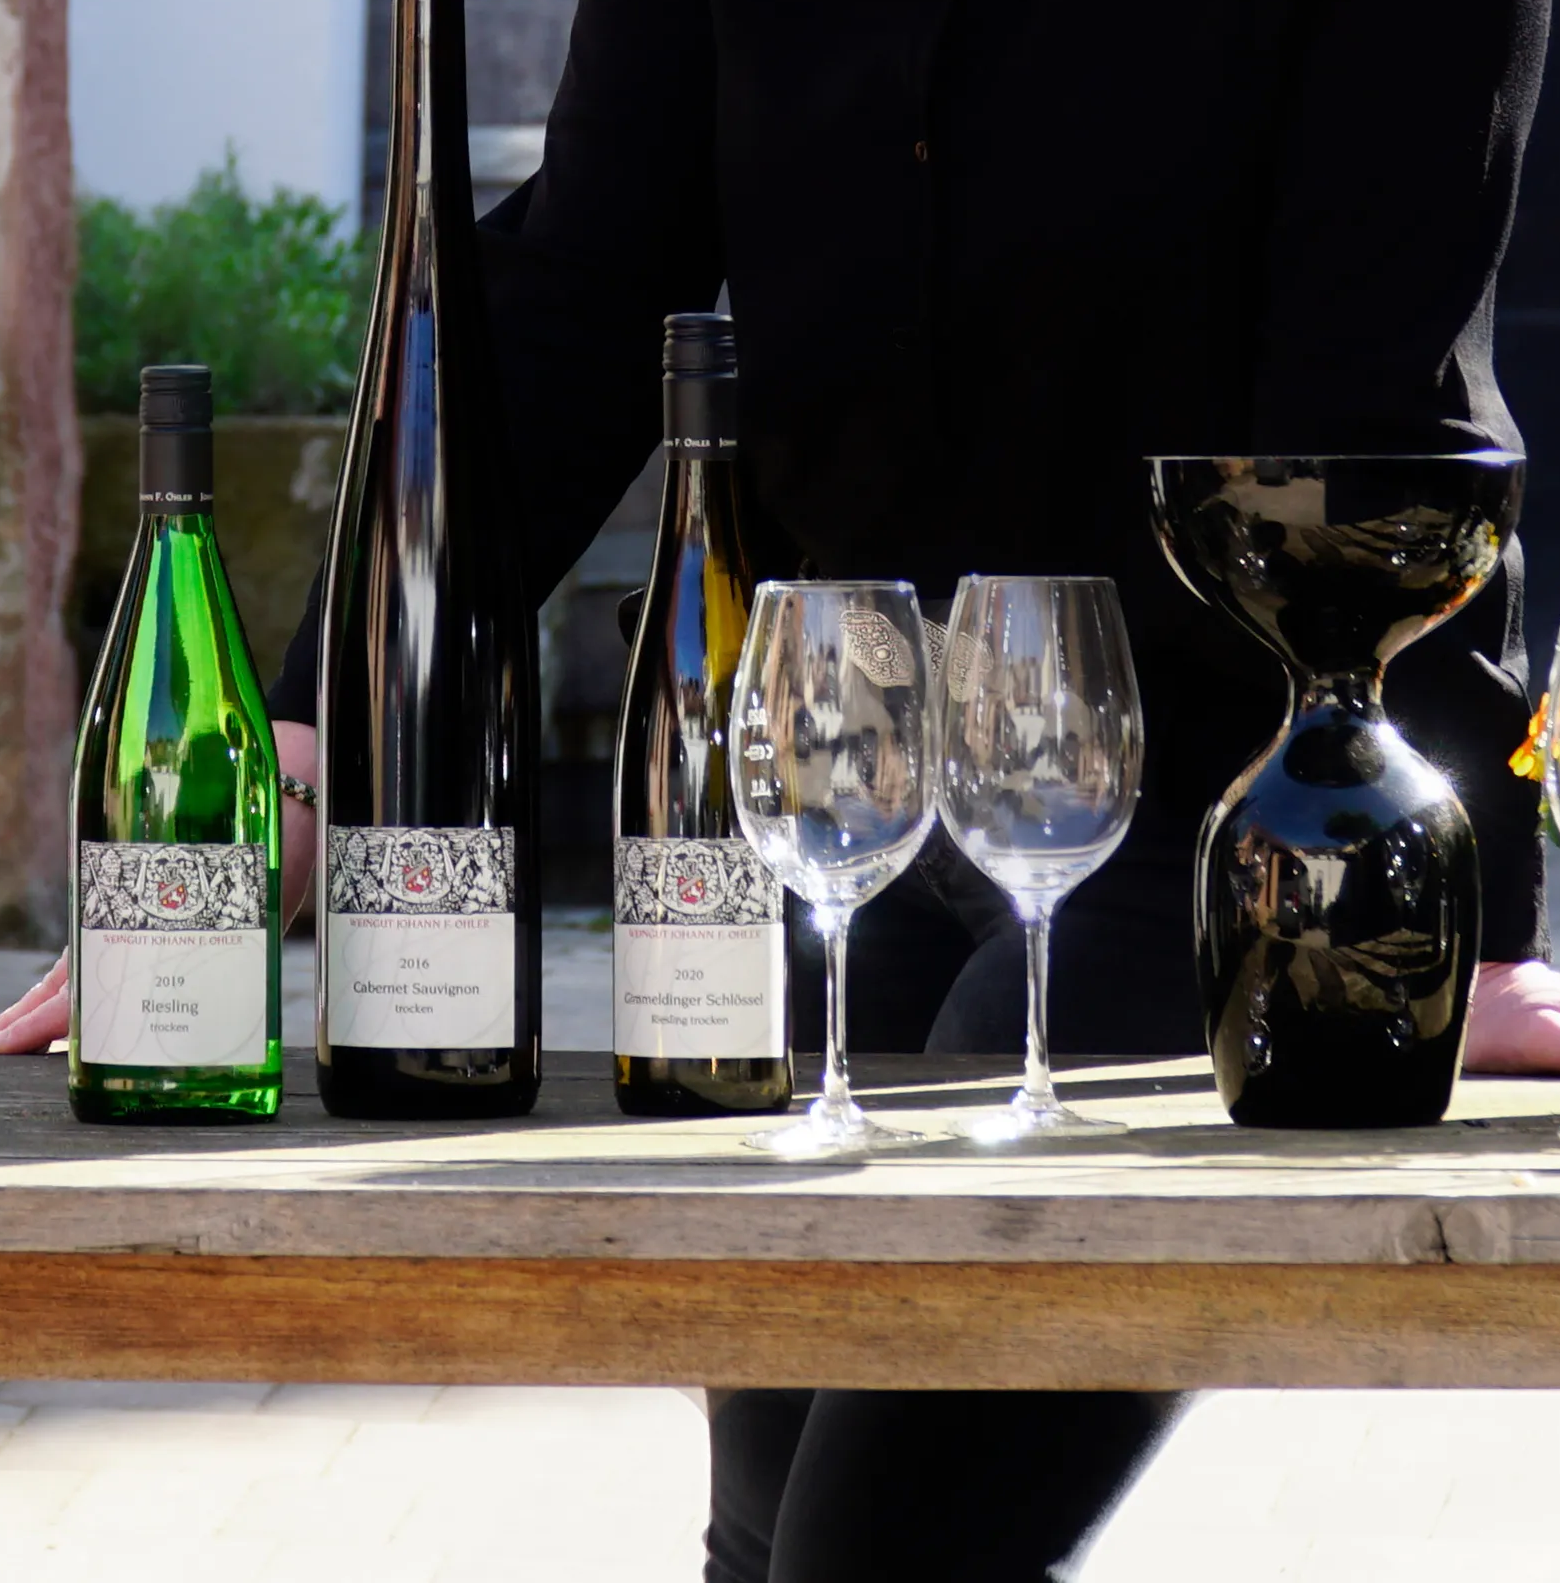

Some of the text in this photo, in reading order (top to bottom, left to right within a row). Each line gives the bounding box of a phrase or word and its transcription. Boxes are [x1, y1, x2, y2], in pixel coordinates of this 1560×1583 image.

[349, 918, 490, 930] WEINGUT JOHANN F. OHLER
[103, 934, 148, 945] WEINGUT
[151, 935, 196, 946] JOHANN
[208, 935, 243, 946] OHLER
[671, 929, 714, 939] JOHANN
[399, 958, 430, 969] 2016
[674, 969, 705, 981] 2020
[155, 976, 186, 988] 2019
[353, 980, 480, 998] Cabernet Sauvignon
[705, 992, 764, 1007] Schlössel
[141, 998, 200, 1017] Riesling
[395, 1003, 434, 1015] trocken
[651, 1014, 729, 1027] Riesling trocken
[149, 1022, 189, 1033] trocken
